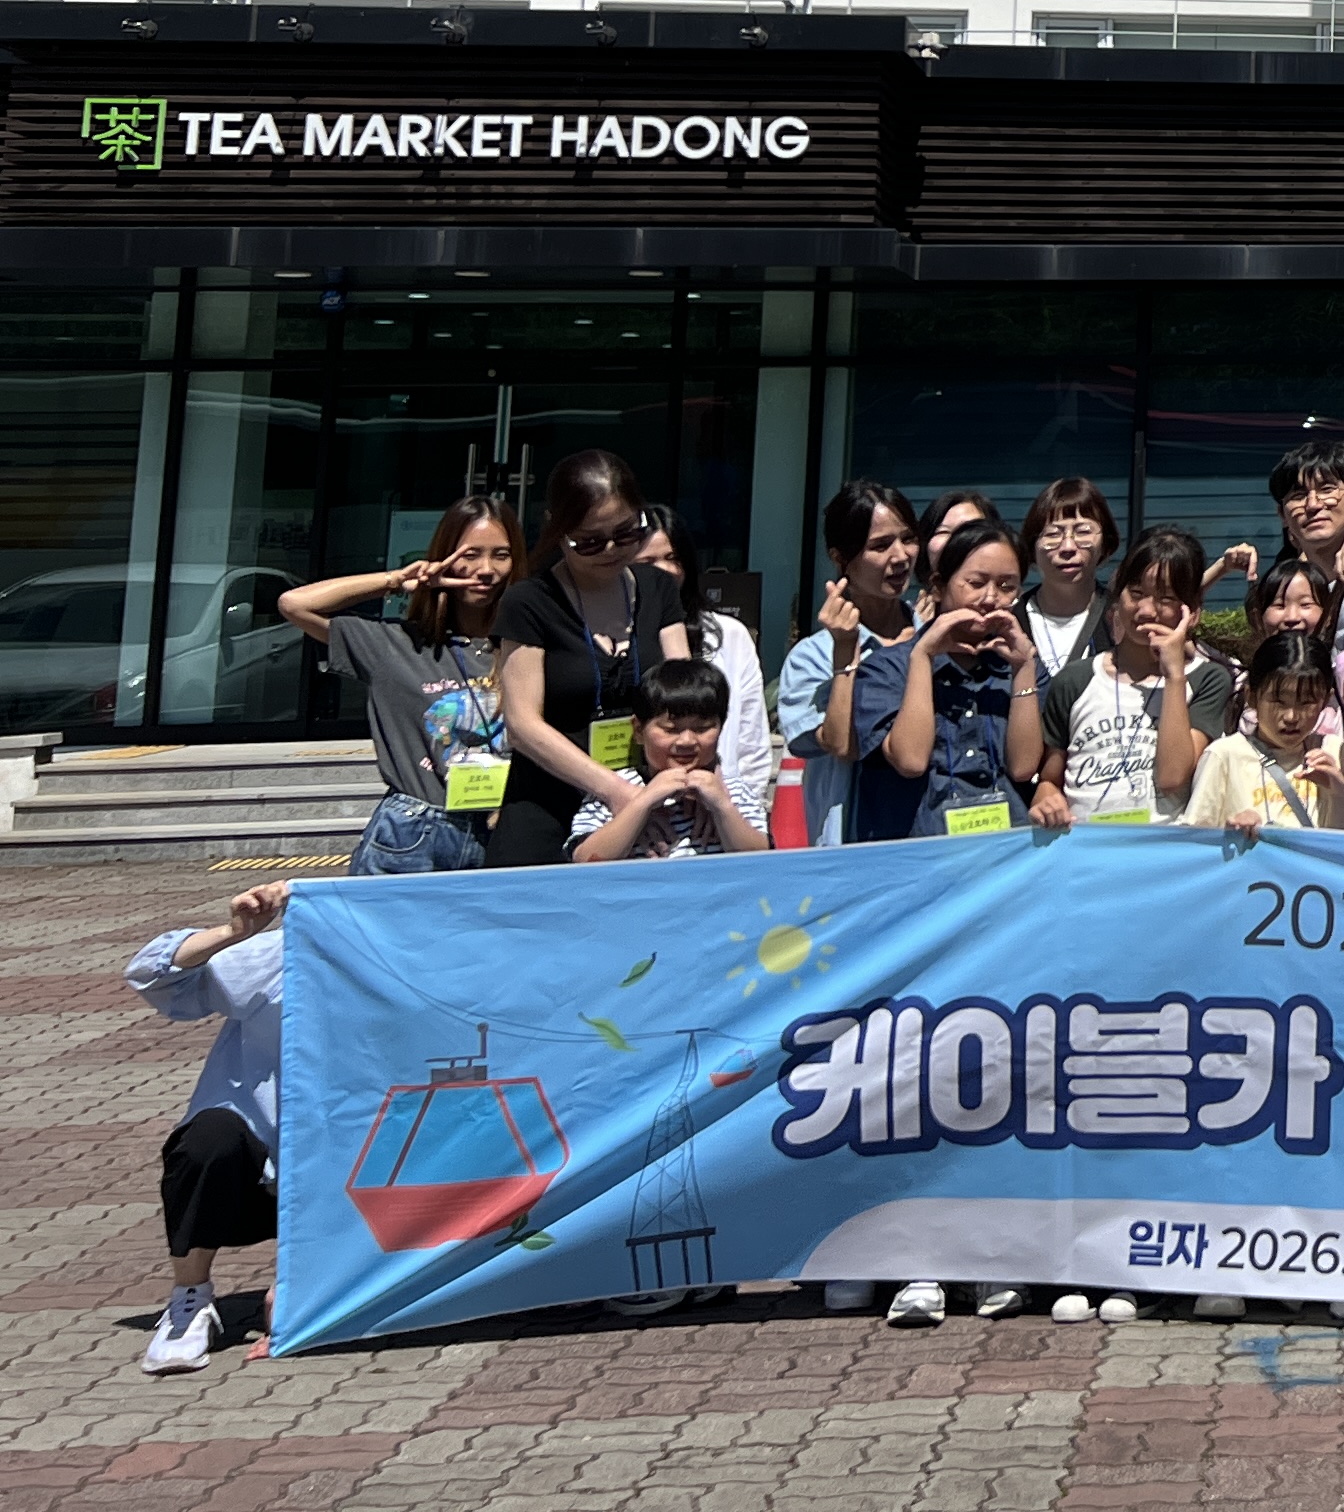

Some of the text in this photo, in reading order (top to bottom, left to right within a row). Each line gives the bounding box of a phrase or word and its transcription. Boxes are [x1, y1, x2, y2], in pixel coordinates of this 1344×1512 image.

[178, 112, 810, 160] TEA MARKET HADONG
[1072, 714, 1158, 751] BROOKL
[774, 995, 1343, 1154] 케이블카
[1128, 1221, 1209, 1268] 일자
